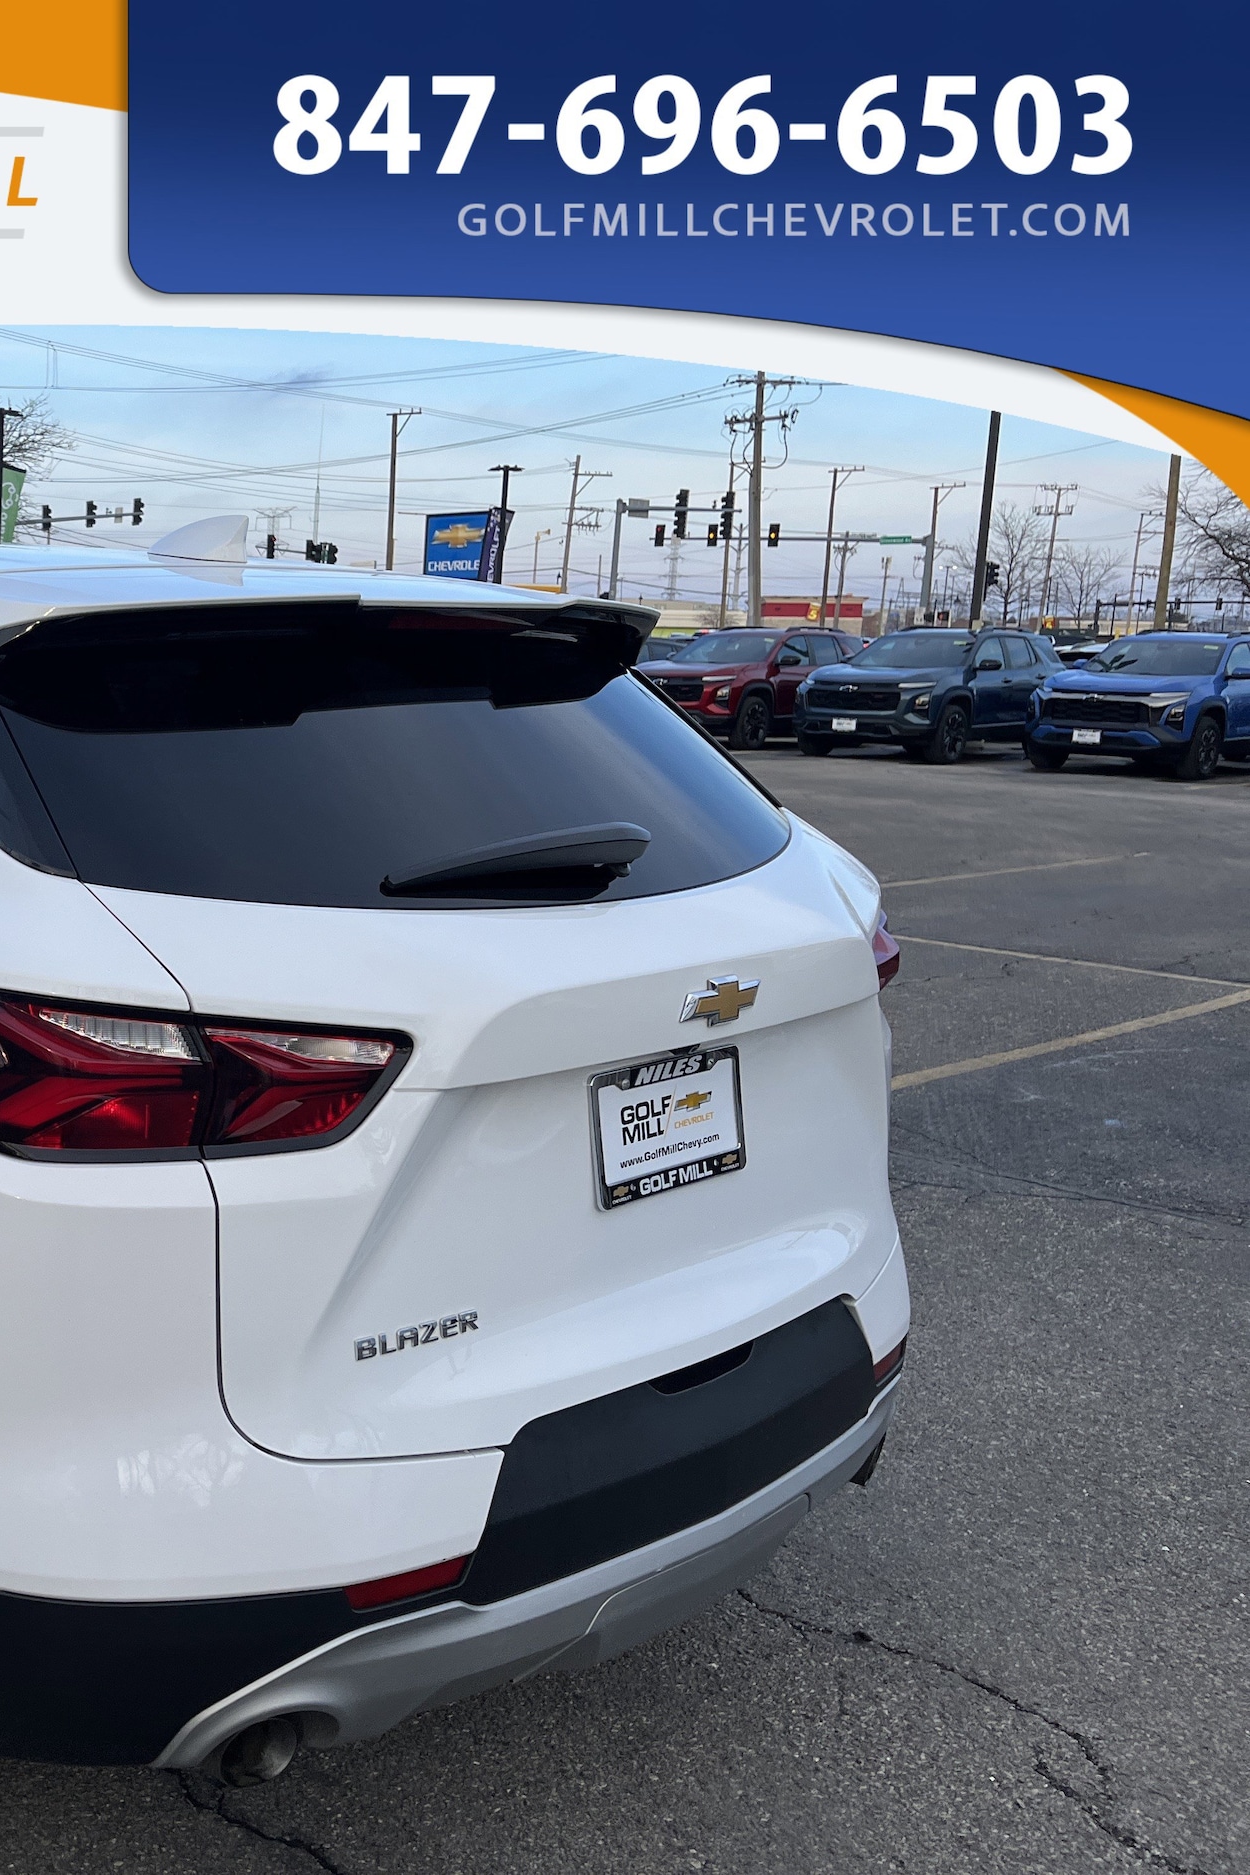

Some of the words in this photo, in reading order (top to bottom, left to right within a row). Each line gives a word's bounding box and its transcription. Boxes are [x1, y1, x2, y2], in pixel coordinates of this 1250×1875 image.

[427, 559, 481, 573] CHEVROLE
[486, 525, 501, 583] EVROLET
[634, 1054, 703, 1087] NILES
[620, 1094, 672, 1126] GOLF
[674, 1111, 715, 1129] CHEVROLET
[621, 1117, 665, 1147] MILL
[619, 1133, 720, 1169] www.GolfMillChevy.com
[639, 1169, 678, 1196] GOLF
[678, 1160, 713, 1184] MILL
[353, 1308, 480, 1362] BLAZER
